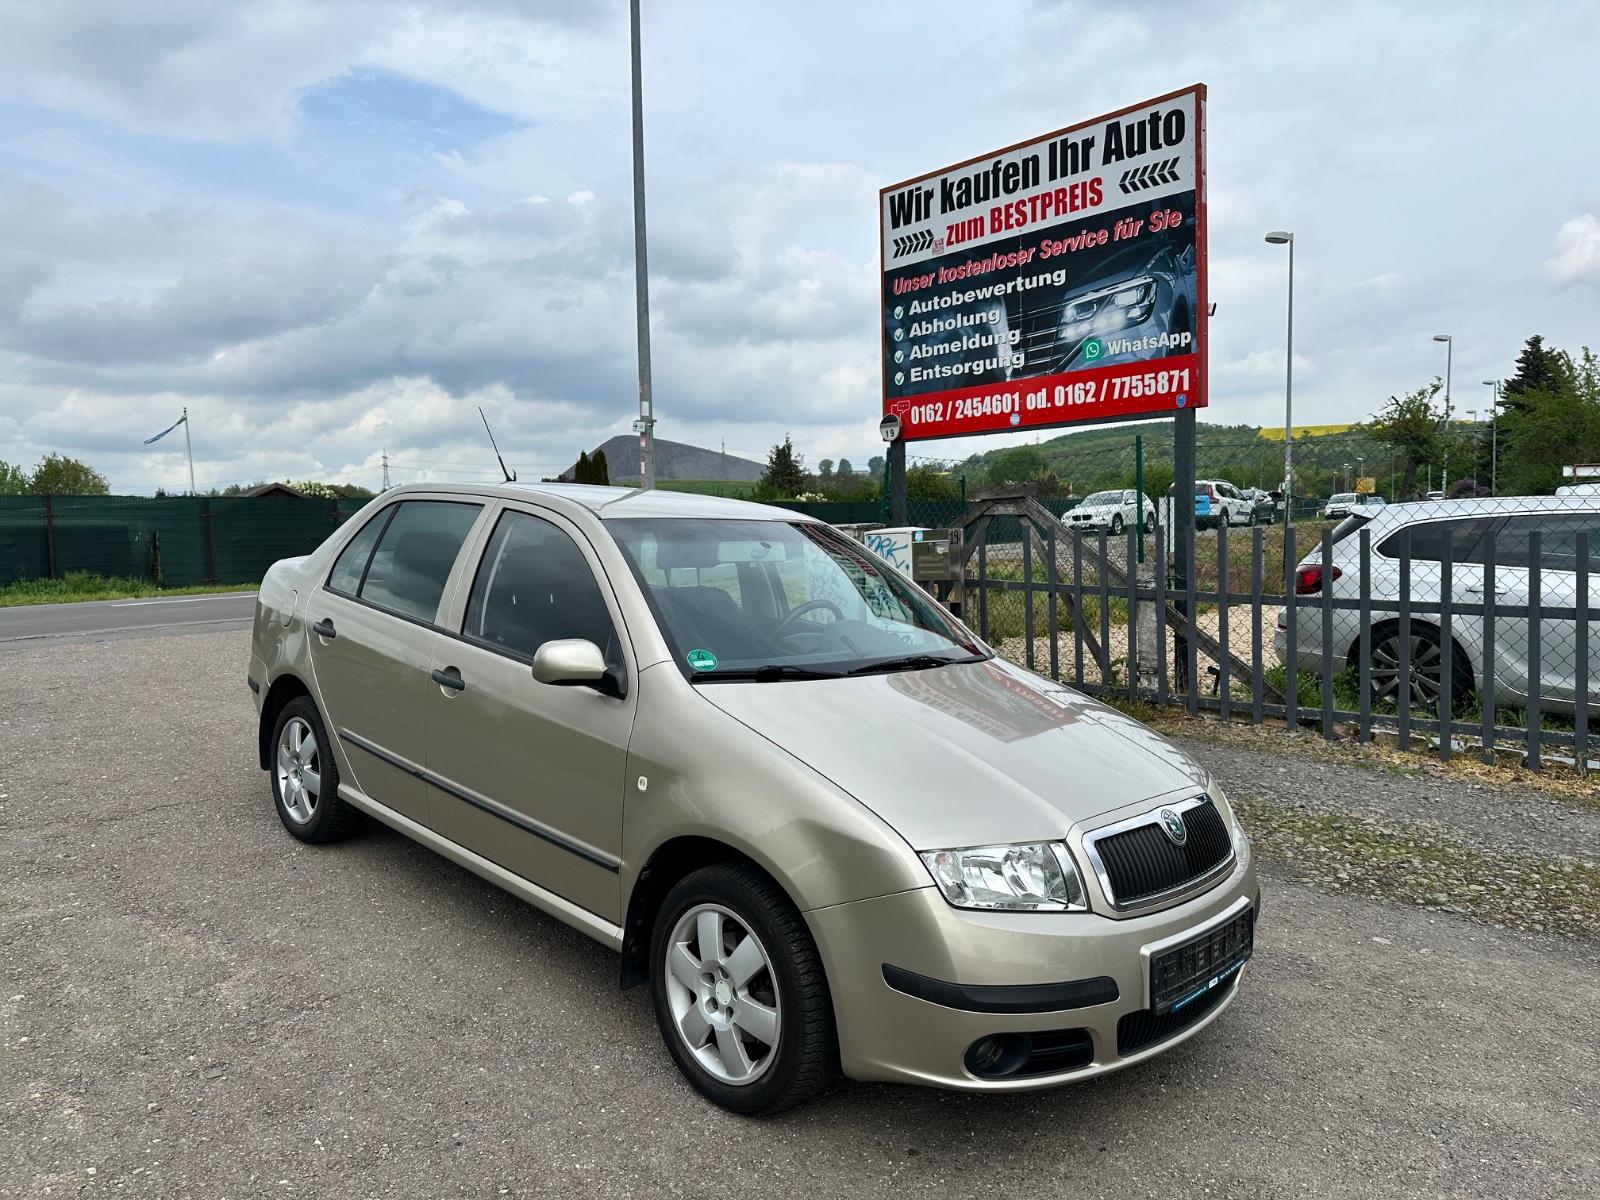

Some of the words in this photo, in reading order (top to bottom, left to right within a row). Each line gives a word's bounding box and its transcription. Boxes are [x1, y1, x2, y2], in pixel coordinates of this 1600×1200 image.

[889, 186, 934, 230] Wir
[940, 154, 1040, 214] kaufen
[1049, 136, 1095, 182] Ihr
[1102, 109, 1185, 166] Auto
[946, 216, 985, 246] zum
[990, 176, 1103, 234] BESTPREIS
[893, 272, 935, 295] Unser
[938, 247, 1035, 284] kostenloser
[1039, 228, 1108, 259] Service
[1113, 217, 1143, 241] für
[1148, 209, 1182, 233] Sie
[909, 269, 1066, 316] Autobewertung
[909, 309, 1000, 338] Abholung
[909, 329, 1021, 360] Abmeldung
[1107, 331, 1191, 355] WhatsApp
[910, 352, 1025, 382] Entsorgung
[911, 403, 943, 424] 0162
[945, 401, 952, 420] /
[955, 392, 1019, 419] 2454601
[1026, 388, 1051, 410] od.
[1054, 381, 1096, 407] 0162
[1100, 379, 1108, 401] /
[1112, 368, 1189, 400] 7755871
[885, 429, 895, 438] 19
[950, 530, 959, 544] 19
